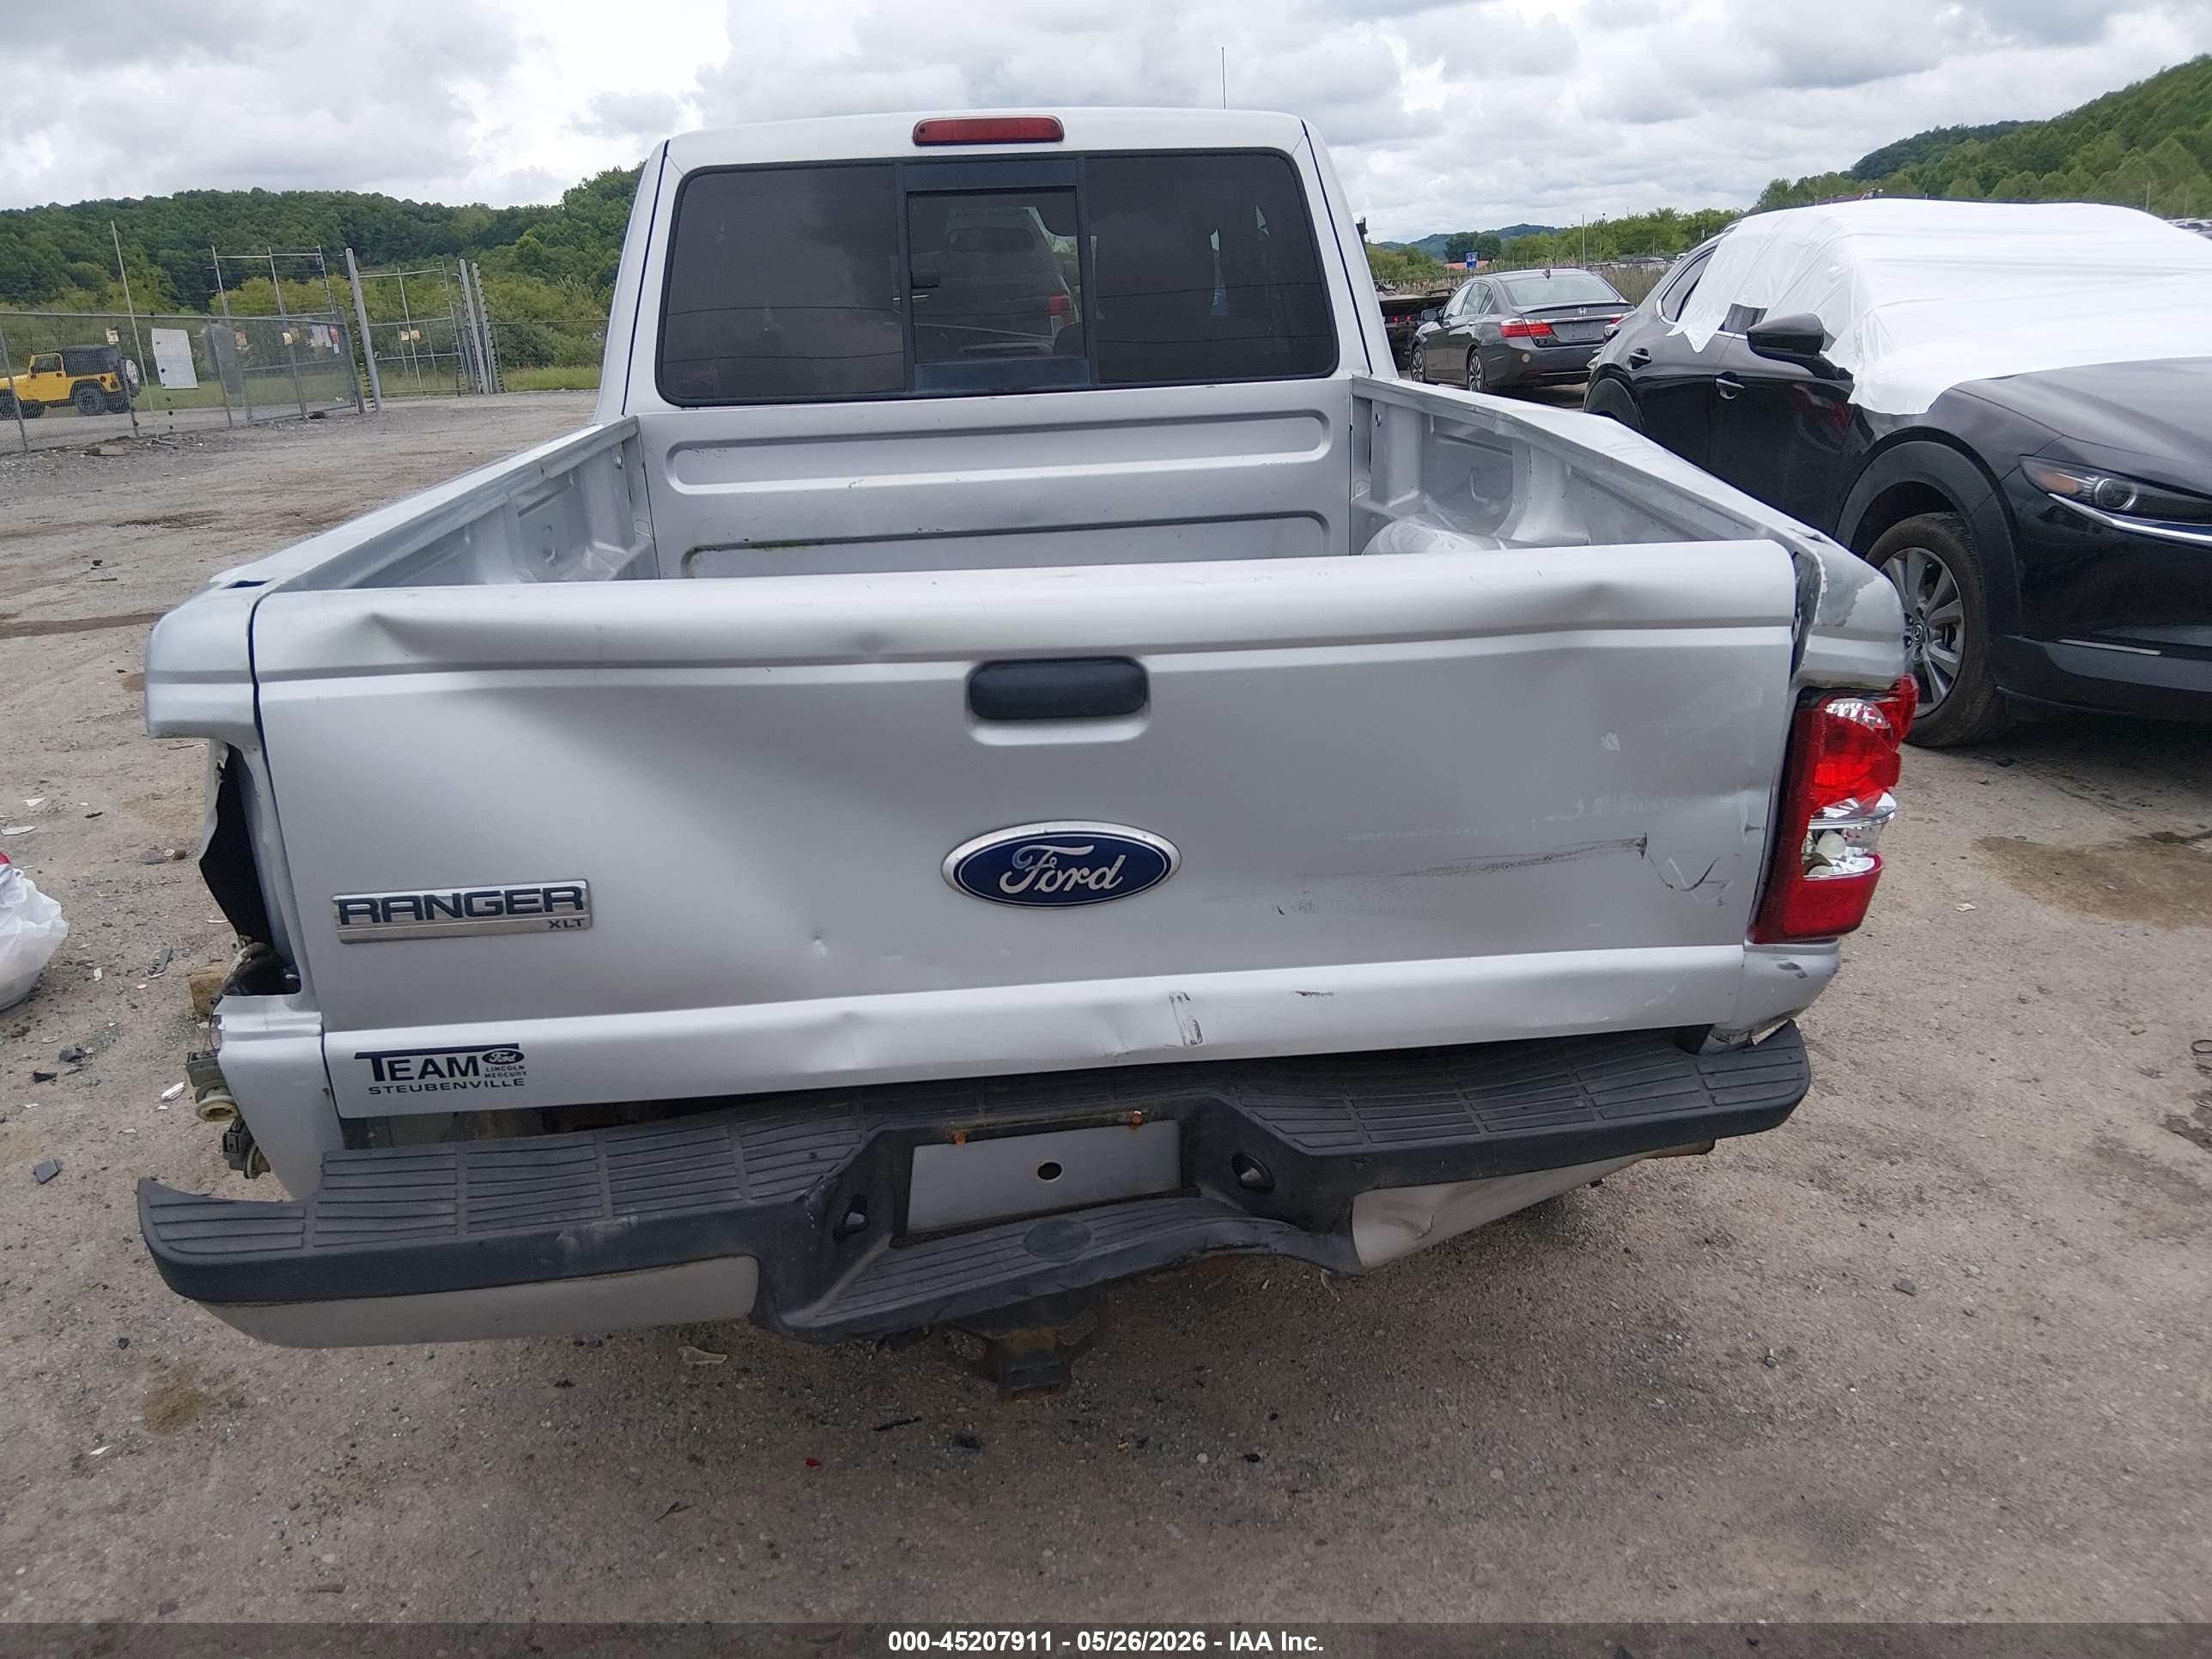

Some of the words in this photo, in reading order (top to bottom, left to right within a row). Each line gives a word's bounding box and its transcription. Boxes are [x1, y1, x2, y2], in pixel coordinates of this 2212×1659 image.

[999, 844, 1126, 894] Ford
[337, 885, 585, 926] RANGER
[547, 918, 586, 930] XLT
[354, 1043, 520, 1082] TEAM
[368, 1078, 525, 1095] STEUBENVILLE
